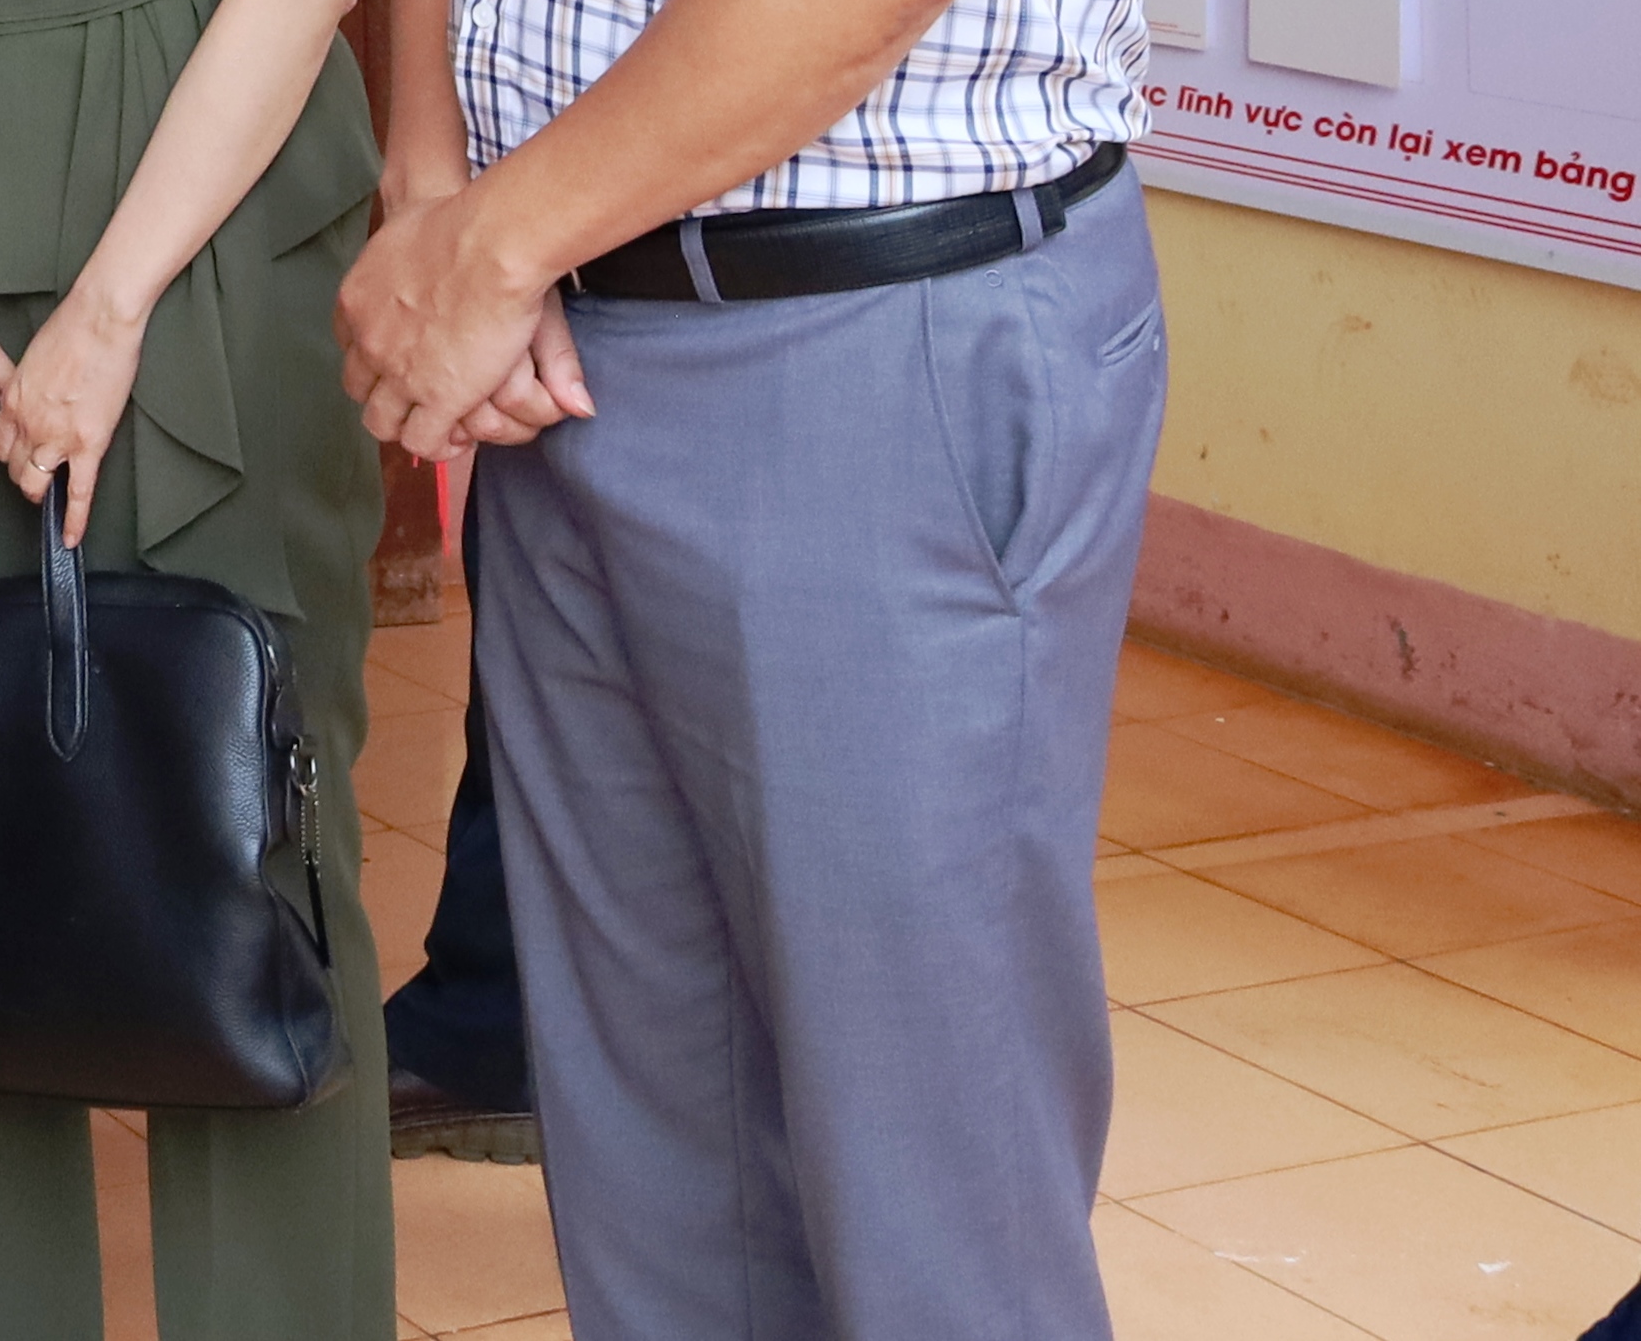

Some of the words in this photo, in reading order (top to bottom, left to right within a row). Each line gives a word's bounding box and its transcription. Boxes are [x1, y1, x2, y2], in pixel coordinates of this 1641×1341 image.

[1176, 84, 1234, 120] lĩnh
[1245, 102, 1303, 136] vực
[1314, 111, 1377, 146] còn
[1388, 123, 1434, 162] lại
[1443, 138, 1523, 173] xem
[1534, 150, 1637, 203] bảng
